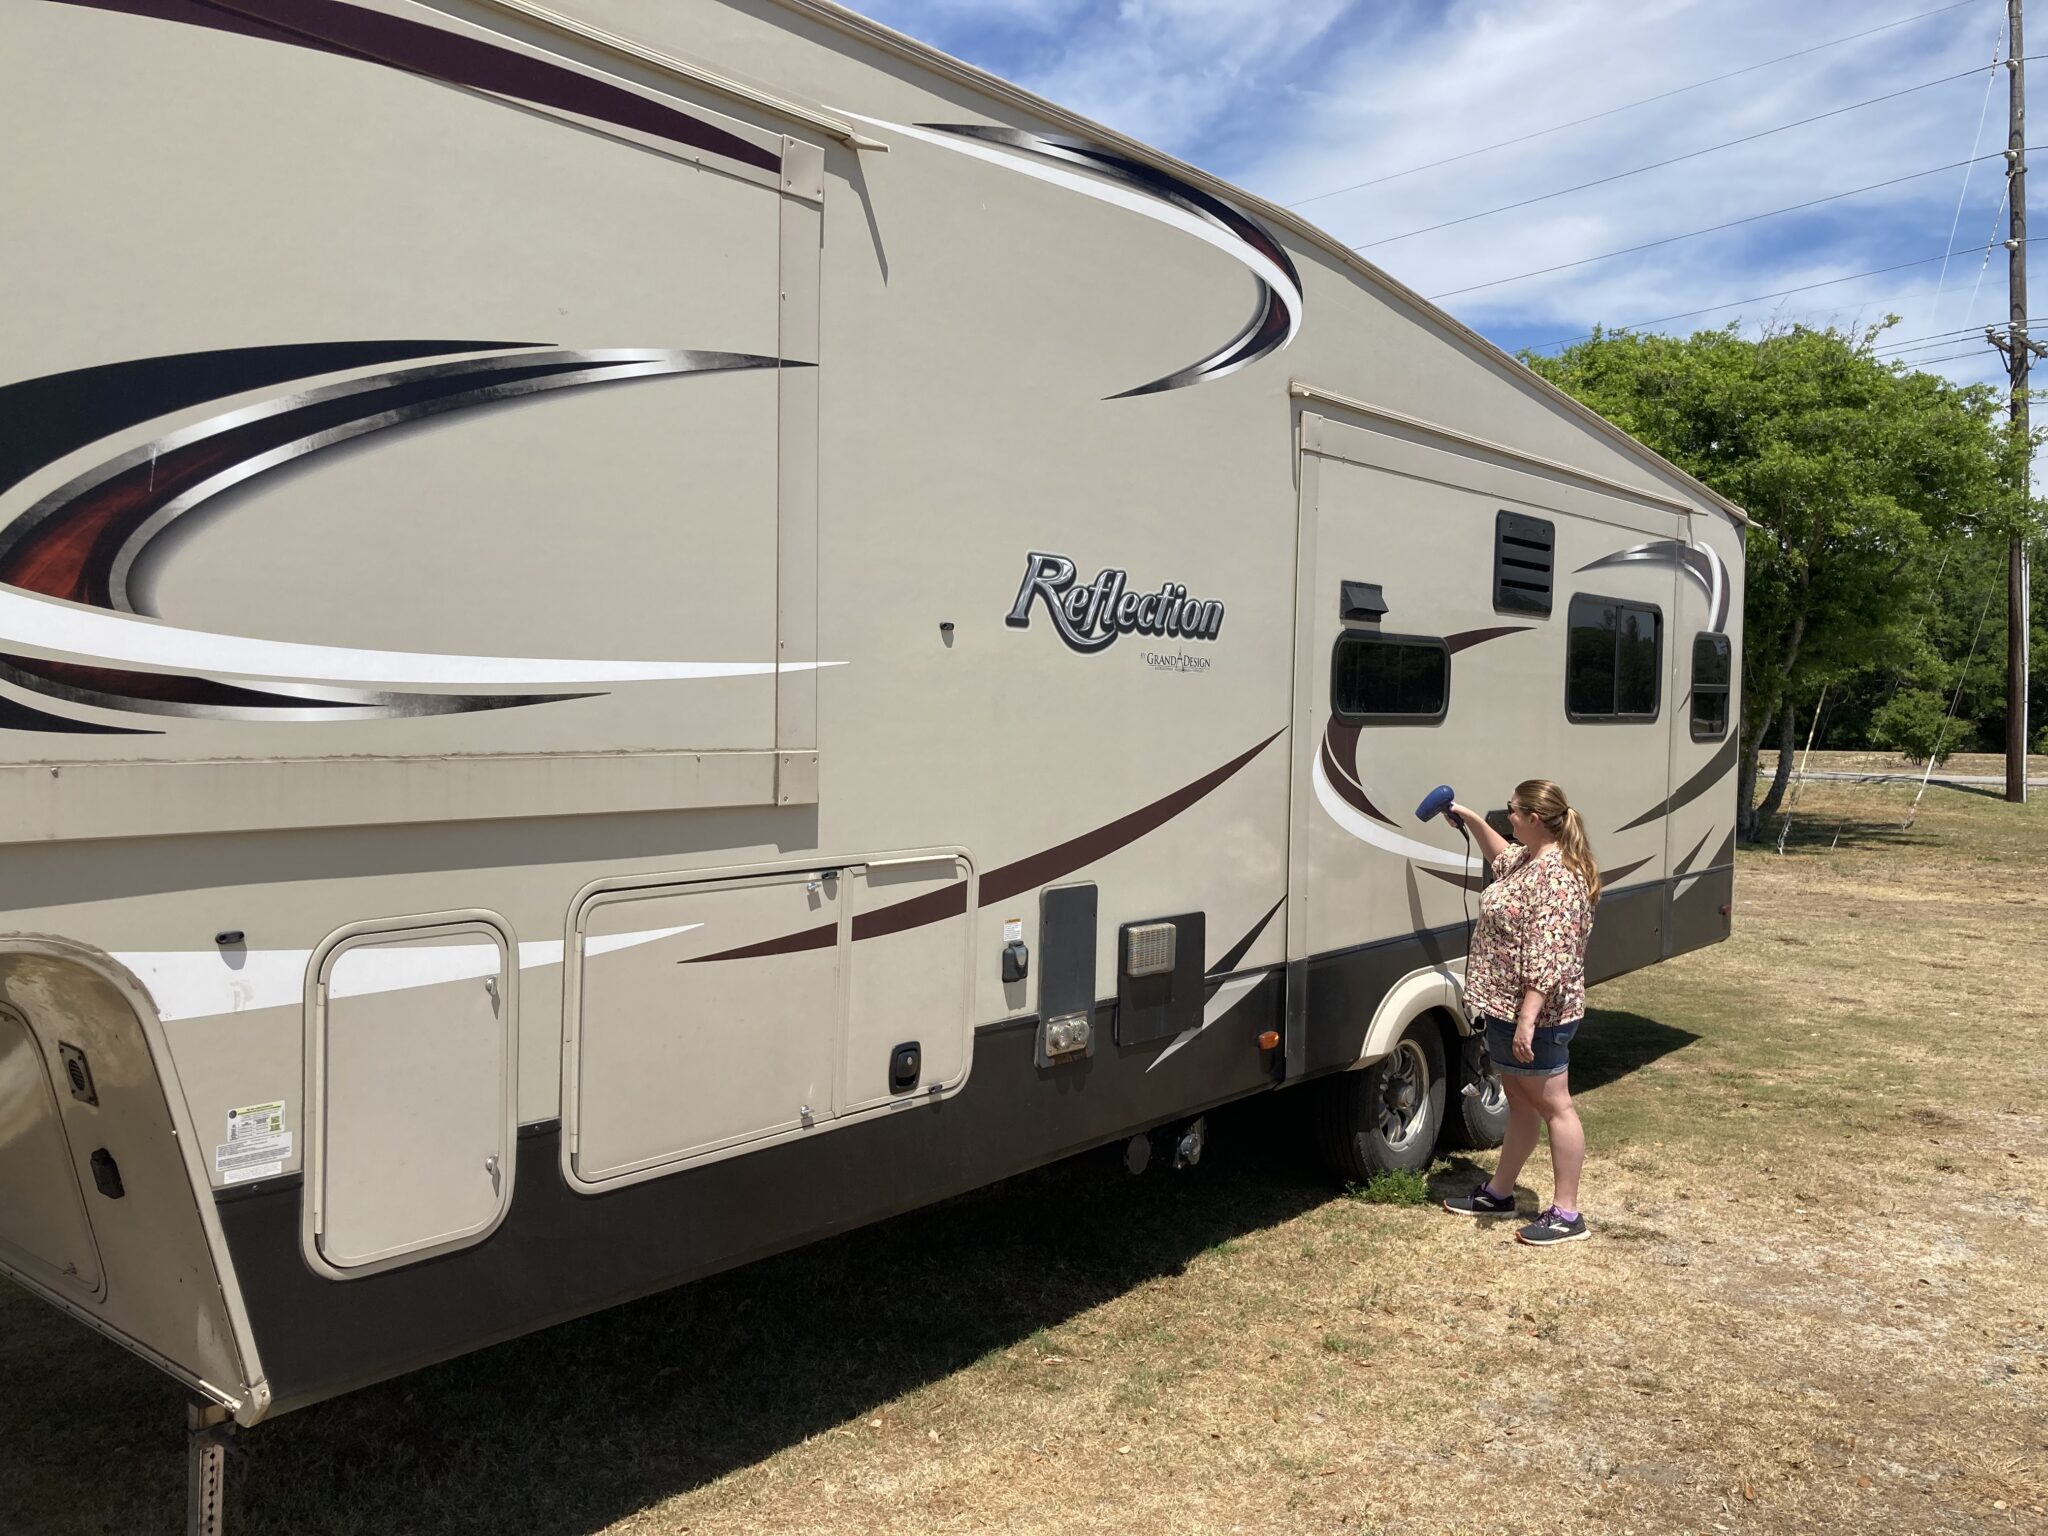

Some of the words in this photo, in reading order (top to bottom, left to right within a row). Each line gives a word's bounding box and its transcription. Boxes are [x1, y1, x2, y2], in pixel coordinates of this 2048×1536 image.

[1006, 552, 1224, 653] Reflection
[1146, 652, 1176, 665] GRAND
[1183, 654, 1211, 668] DESIGN
